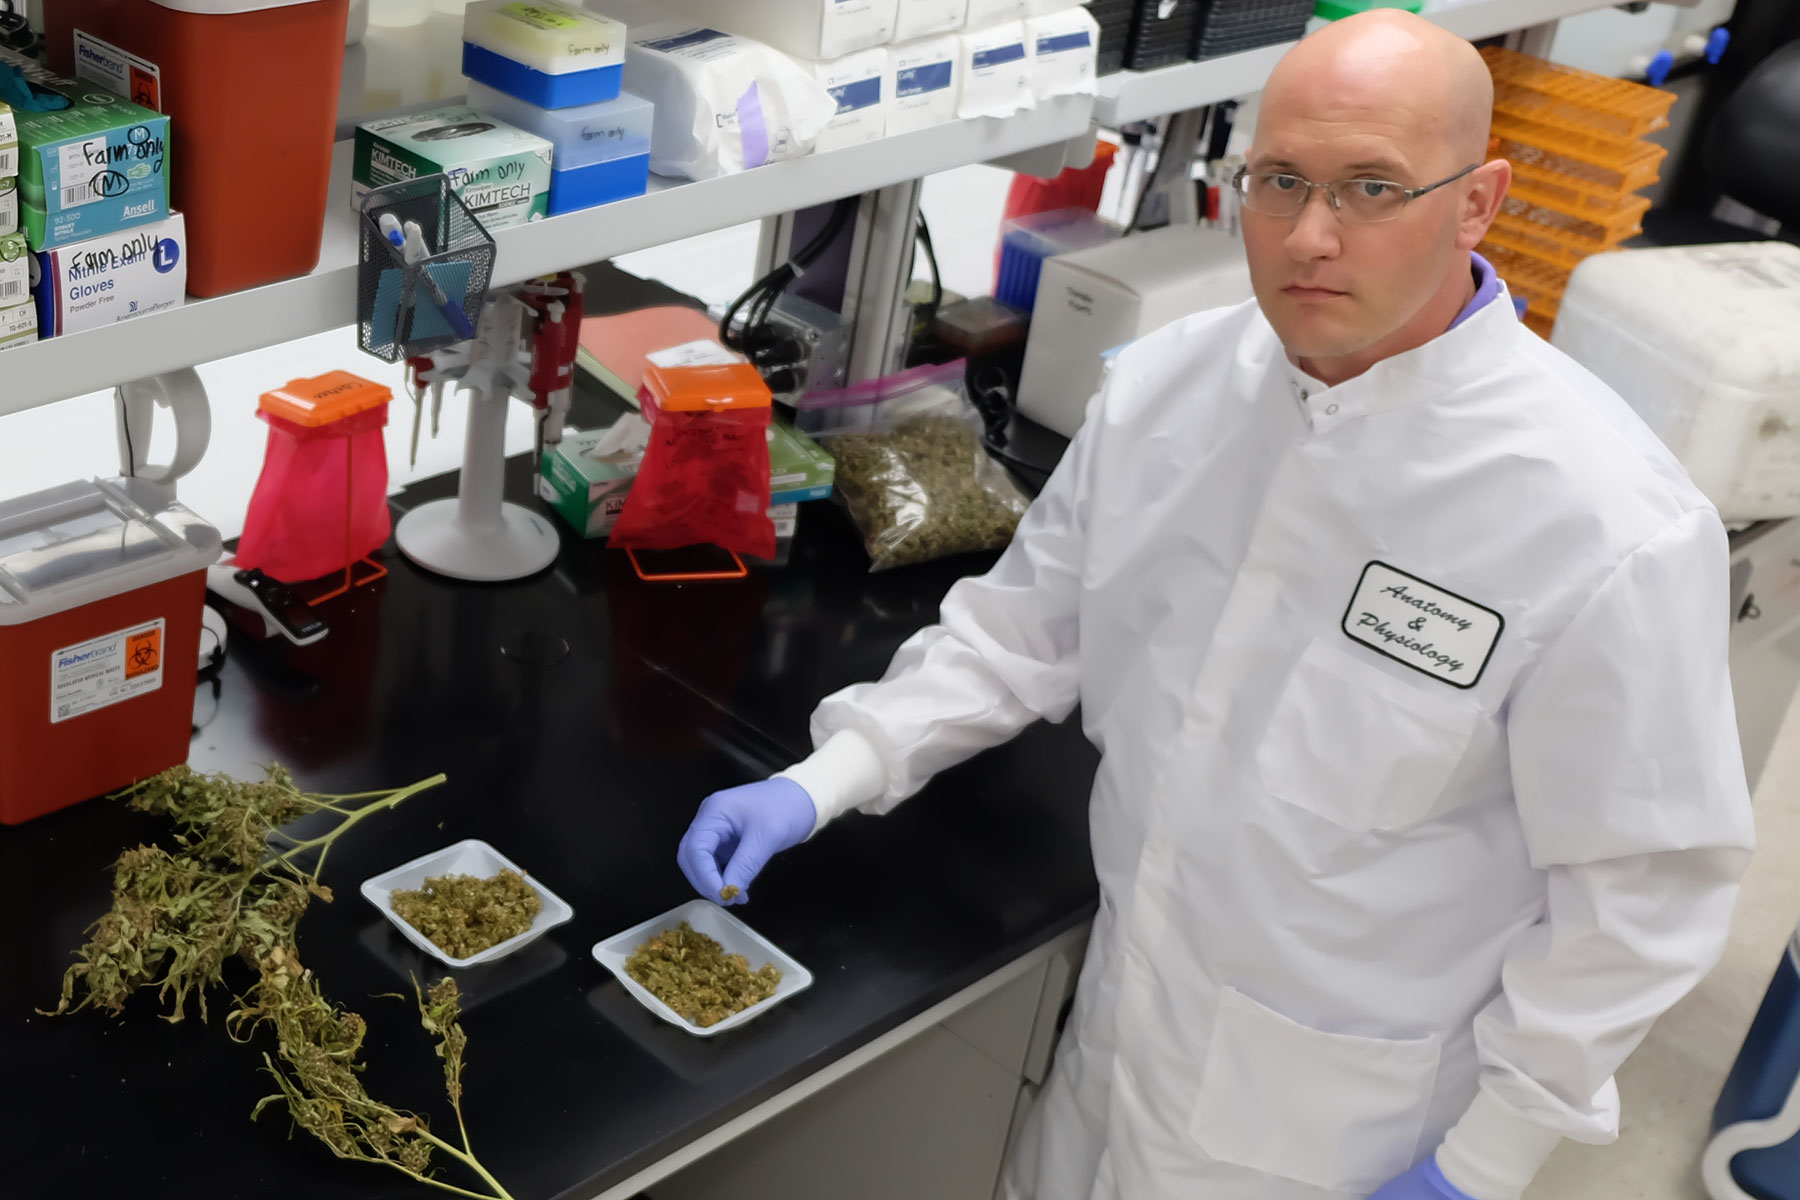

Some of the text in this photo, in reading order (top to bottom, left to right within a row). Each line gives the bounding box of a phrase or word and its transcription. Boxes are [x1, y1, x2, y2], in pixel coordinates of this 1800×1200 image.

[593, 43, 610, 56] only
[134, 128, 145, 140] M
[607, 126, 625, 141] only
[83, 142, 129, 167] Farm
[136, 136, 164, 174] only
[371, 148, 417, 178] KIMTECH
[498, 161, 526, 181] only
[464, 183, 532, 208] KIMTECH
[54, 213, 81, 224] 92-500
[123, 200, 155, 218] Ansell
[8, 241, 14, 250] S
[70, 232, 161, 272] Farm only
[160, 245, 173, 267] L
[68, 252, 146, 282] Nitrile Exam
[70, 279, 115, 300] Gloves
[70, 295, 115, 314] Powder Free
[1379, 585, 1473, 632] Anatomy
[1407, 616, 1428, 632] &
[1356, 611, 1465, 673] Physiology
[58, 642, 117, 668] Fisherbrand
